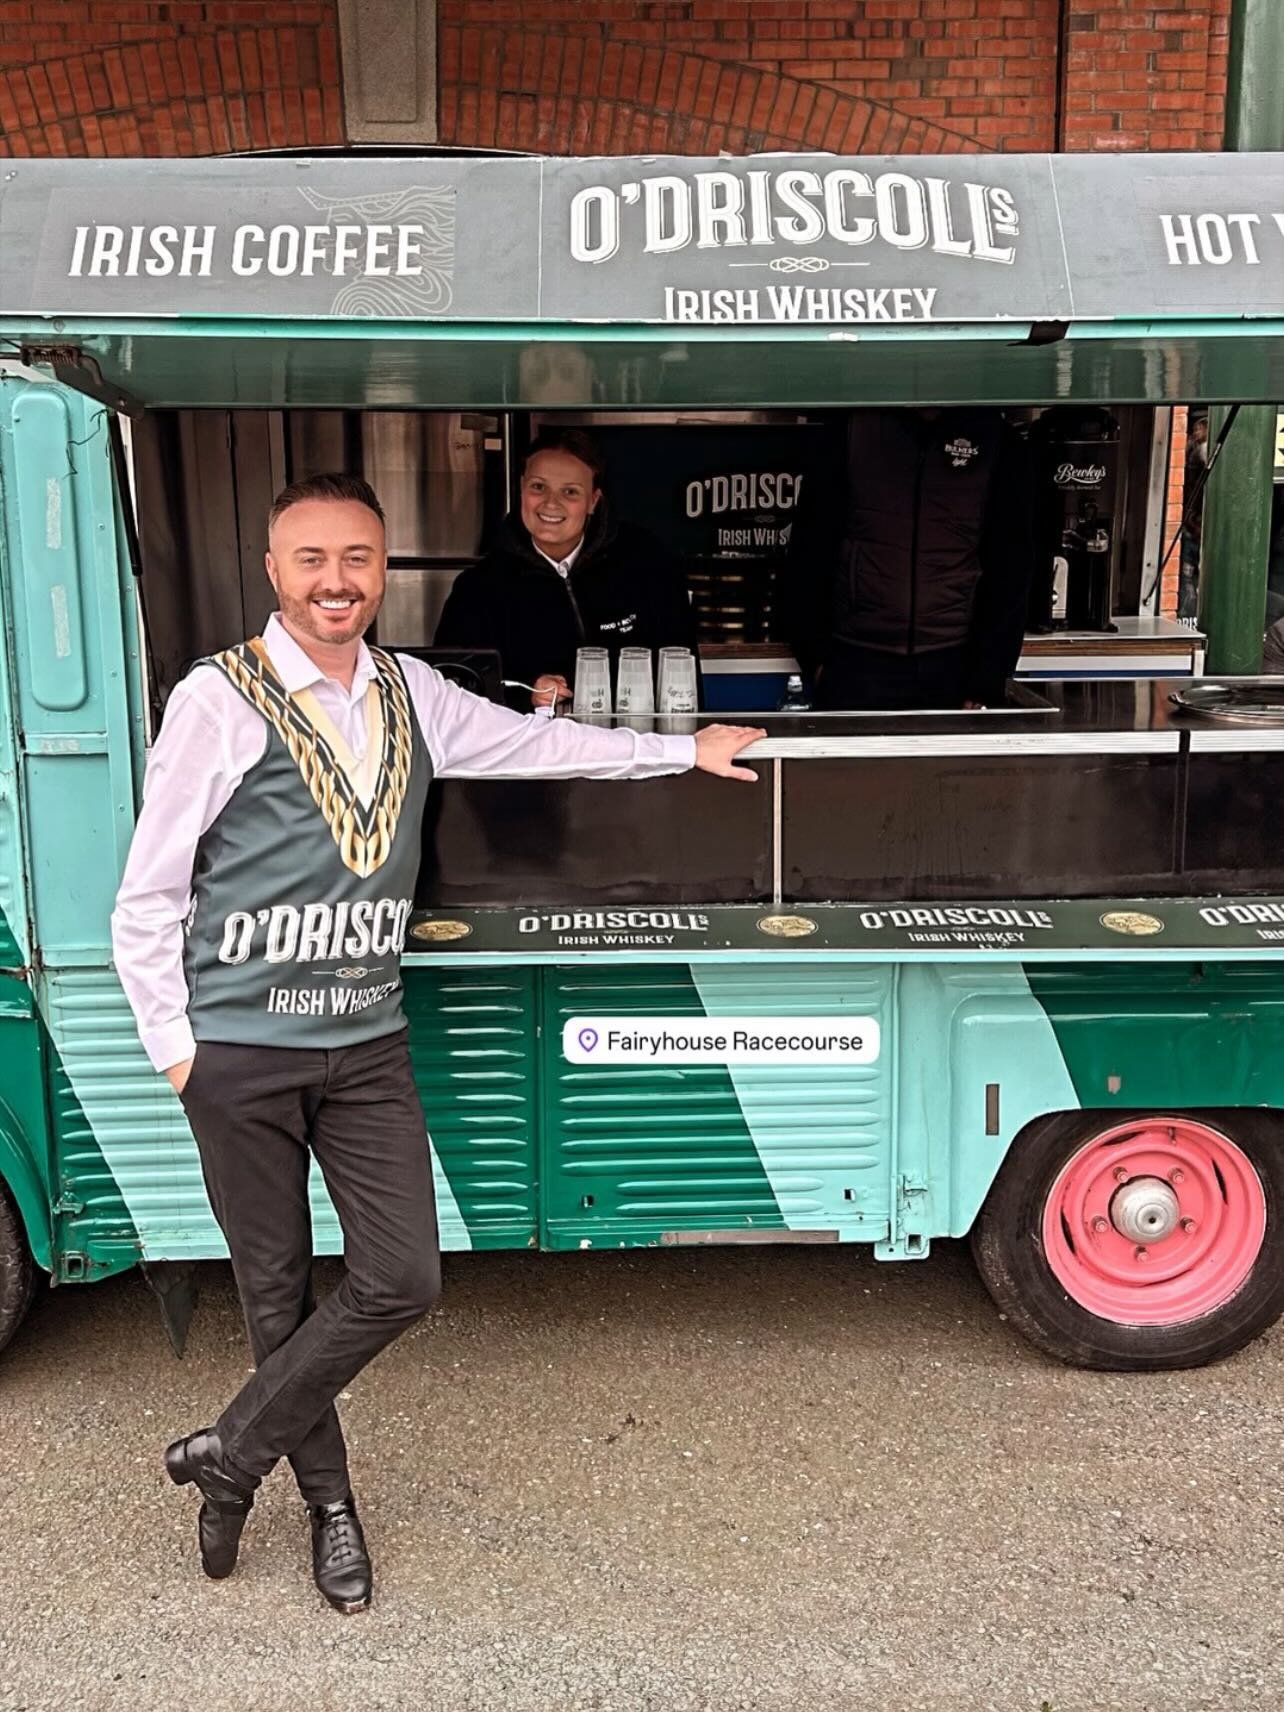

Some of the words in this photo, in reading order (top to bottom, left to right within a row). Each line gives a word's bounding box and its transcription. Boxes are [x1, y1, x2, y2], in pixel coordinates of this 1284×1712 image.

[68, 225, 216, 277] IRISH
[231, 225, 424, 277] COFFEE
[1158, 213, 1261, 265] HOT
[664, 286, 759, 322] IRISH
[766, 285, 938, 322] WHISKEY
[718, 528, 751, 546] IRISH
[1199, 903, 1284, 927] O'DRI
[558, 935, 599, 945] IRISH
[602, 934, 675, 945] WHISKEY
[908, 931, 951, 942] IRISH
[953, 931, 1025, 942] WHISKEY
[267, 986, 324, 1016] IRISH
